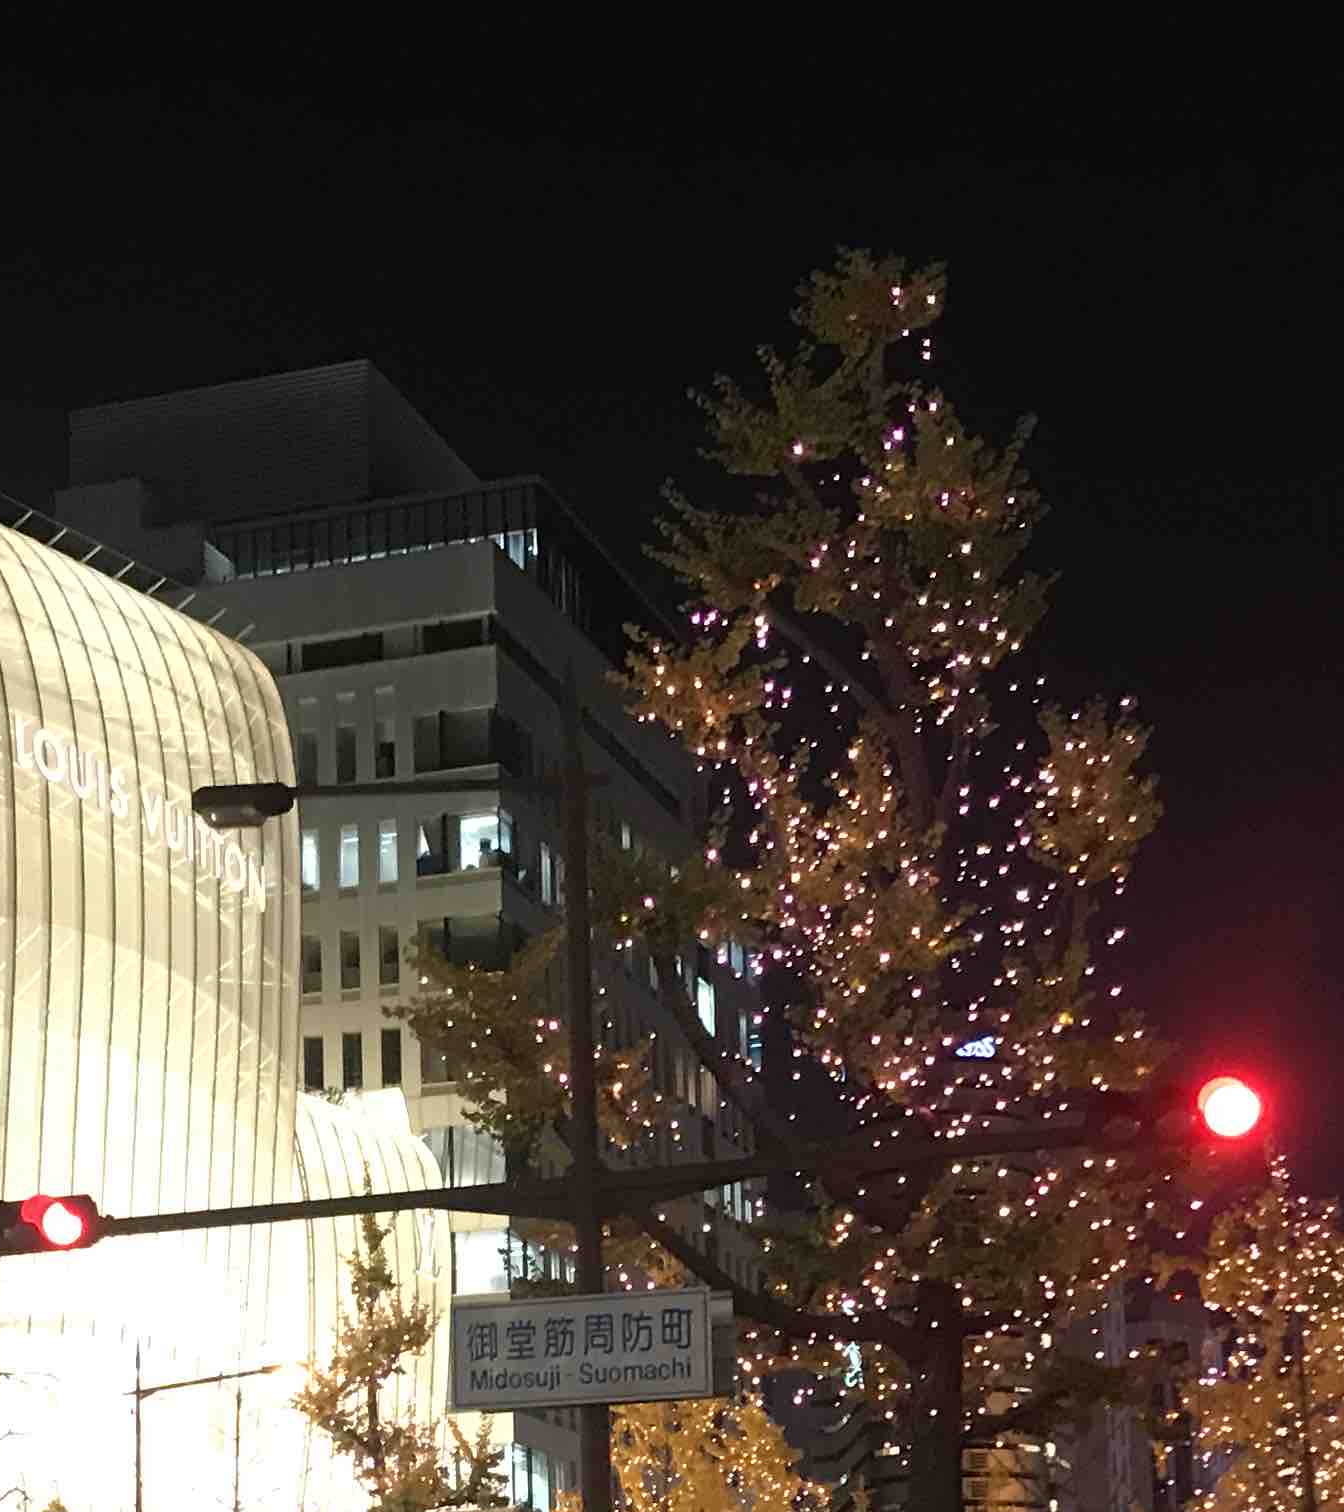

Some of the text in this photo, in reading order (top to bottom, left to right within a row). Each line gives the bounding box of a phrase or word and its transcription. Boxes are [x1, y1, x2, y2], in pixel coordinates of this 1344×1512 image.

[13, 715, 266, 913] LOUIS VUITTON
[465, 1307, 693, 1362] 御堂筋周防町
[469, 1366, 561, 1392] Midosuji
[579, 1357, 691, 1385] Suomachi
